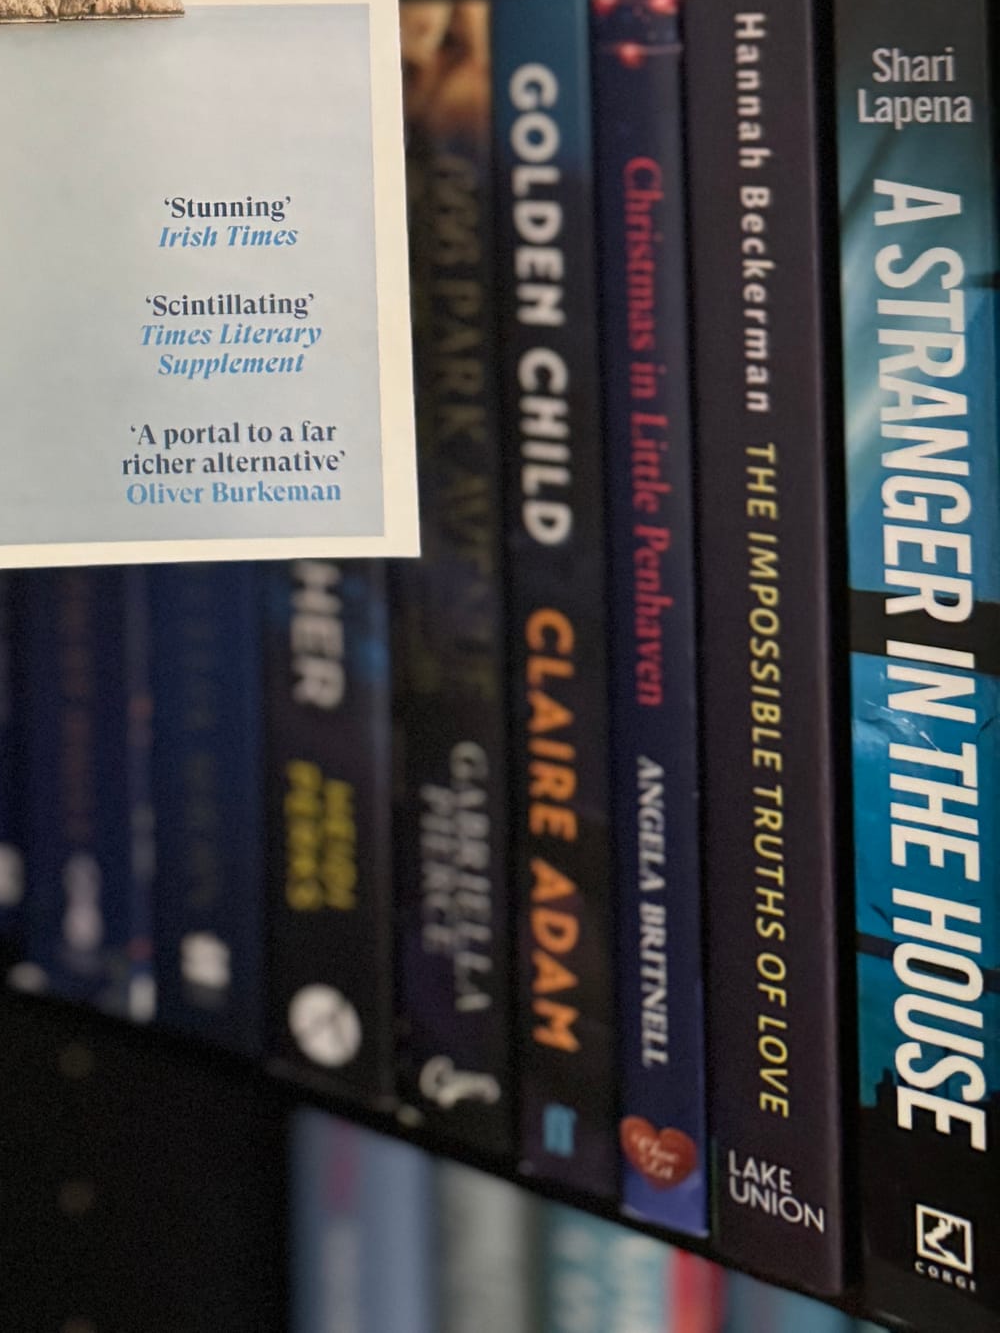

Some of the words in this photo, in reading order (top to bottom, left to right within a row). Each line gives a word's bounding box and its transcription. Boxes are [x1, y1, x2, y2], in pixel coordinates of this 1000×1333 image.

[735, 13, 771, 169] Hannah
[857, 88, 971, 128] Lapena
[871, 47, 954, 84] Shari
[158, 226, 217, 247] Irish
[227, 225, 298, 246] Times
[164, 196, 291, 222] ‘Stunning’
[509, 63, 565, 327] GOLDEN
[873, 178, 961, 226] A
[624, 157, 665, 352] Christmas
[141, 325, 212, 346] Times
[219, 324, 322, 348] Literary
[146, 294, 314, 319] ‘Scintillating’
[741, 186, 776, 412] Beckerman
[158, 353, 304, 380] Supplement
[631, 363, 666, 400] in
[122, 453, 195, 475] richer
[203, 450, 346, 474] alternative’
[131, 424, 156, 445] ‘A
[164, 422, 239, 449] portal
[248, 424, 273, 443] to
[280, 428, 294, 442] a
[301, 421, 337, 441] far
[518, 346, 572, 546] CHILD
[630, 413, 670, 514] Little
[874, 244, 975, 625] STRANGER
[127, 482, 202, 505] Oliver
[212, 480, 341, 503] Burkeman
[745, 443, 778, 521] THE
[634, 525, 673, 706] Penhaven
[747, 531, 782, 771] IMPOSSIBLE
[885, 639, 976, 724] IN
[525, 608, 577, 843] CLAIRE
[638, 756, 664, 893] ANGELA
[889, 741, 980, 882] THE
[752, 782, 785, 942] TRUTHS
[530, 859, 580, 1053] ADAM
[640, 901, 668, 1066] BRITNELL
[757, 954, 787, 1005] OF
[891, 886, 987, 1152] HOUSE
[757, 1015, 789, 1118] LOVE
[729, 1149, 792, 1195] LAKE
[729, 1181, 825, 1234] UNION
[915, 1260, 976, 1293] CORGI
